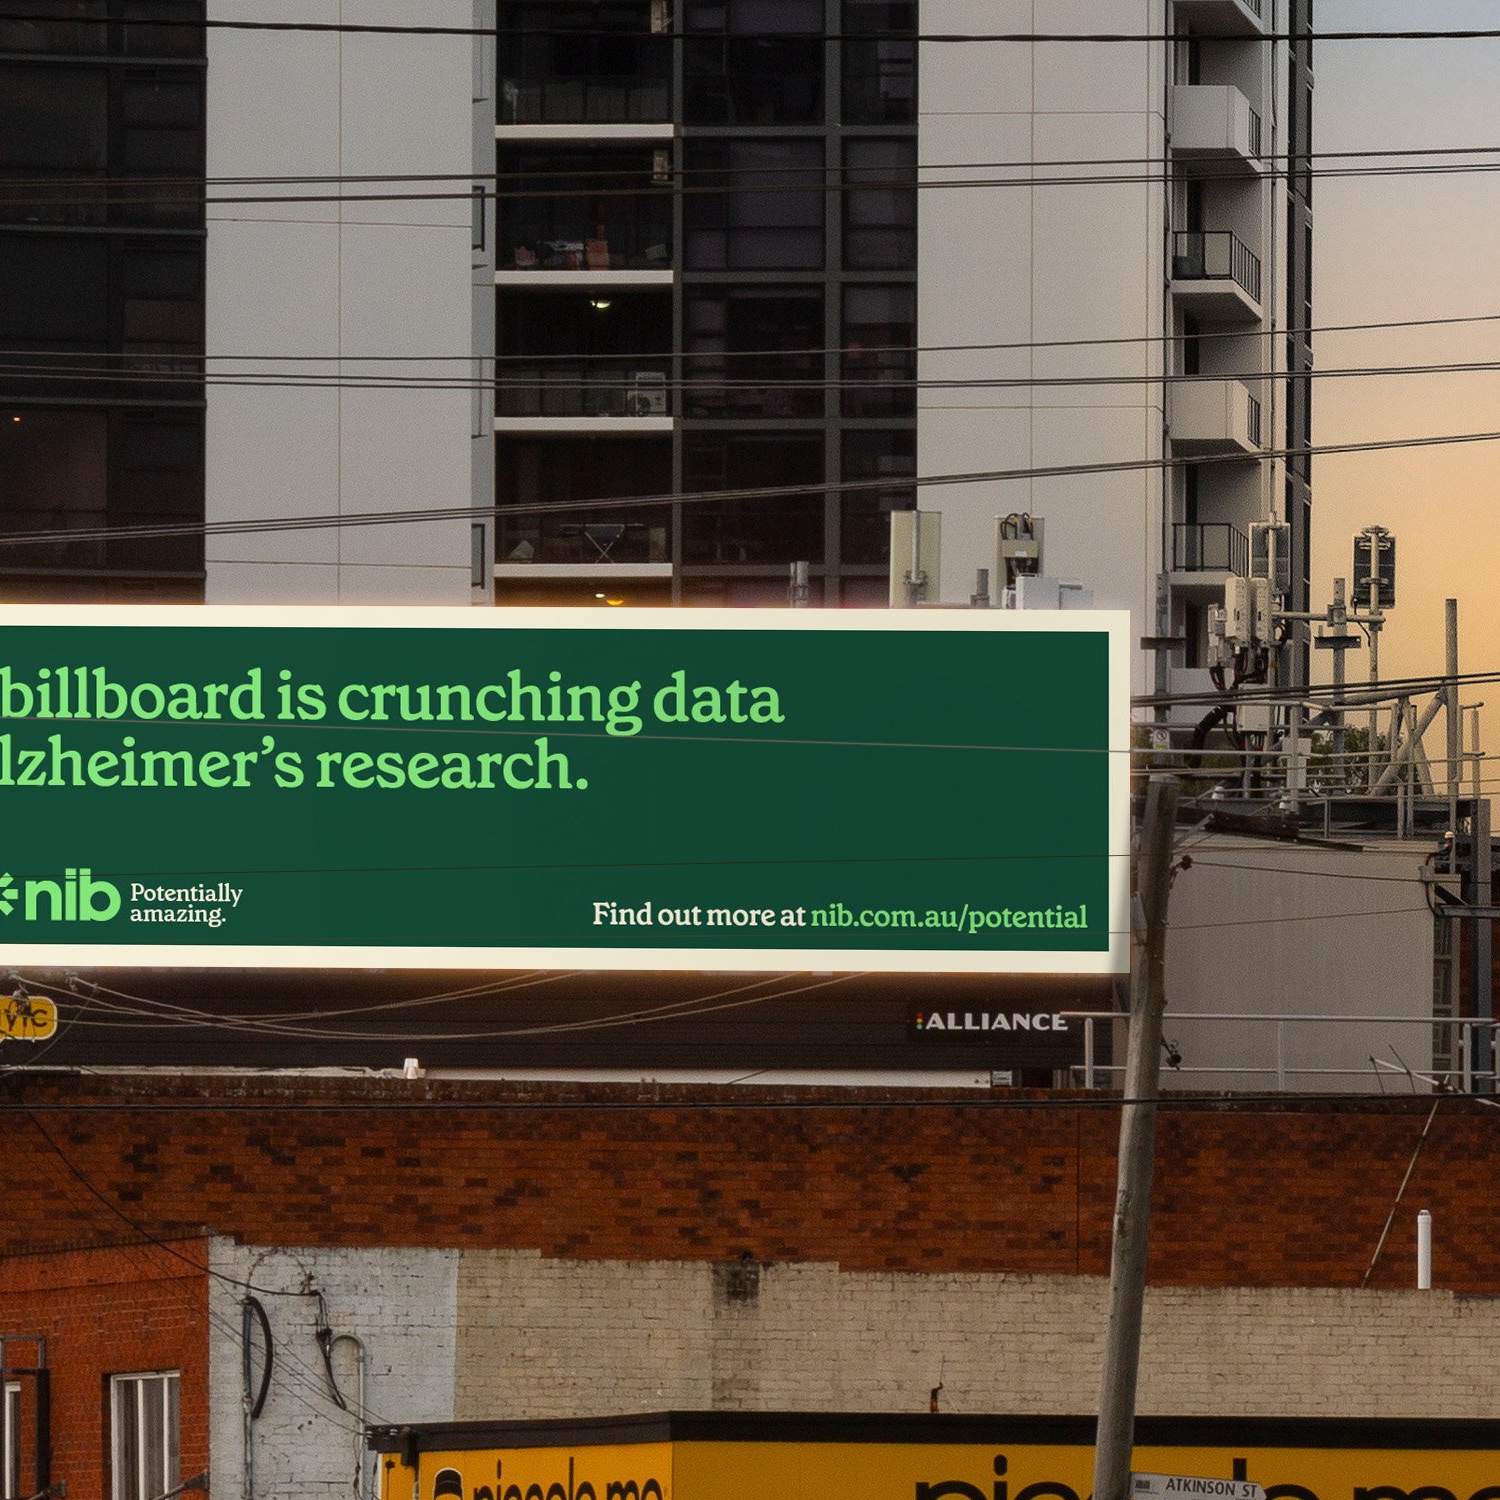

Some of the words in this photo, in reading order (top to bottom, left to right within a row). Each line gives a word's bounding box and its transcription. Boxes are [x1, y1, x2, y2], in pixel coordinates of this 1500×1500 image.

[278, 669, 327, 721] is
[338, 669, 643, 737] crunching
[653, 670, 786, 723] data
[316, 737, 589, 790] research.
[25, 868, 122, 921] nib
[130, 882, 244, 906] Potentially
[130, 904, 238, 928] amazing.
[592, 902, 653, 926] Find
[657, 906, 703, 926] out
[706, 908, 776, 927] more
[780, 906, 807, 926] at
[810, 903, 1089, 934] nib.com.au/potential
[925, 1012, 1069, 1032] ALLIANCE
[1165, 1477, 1236, 1496] ATKINSON
[1241, 1484, 1258, 1498] ST
